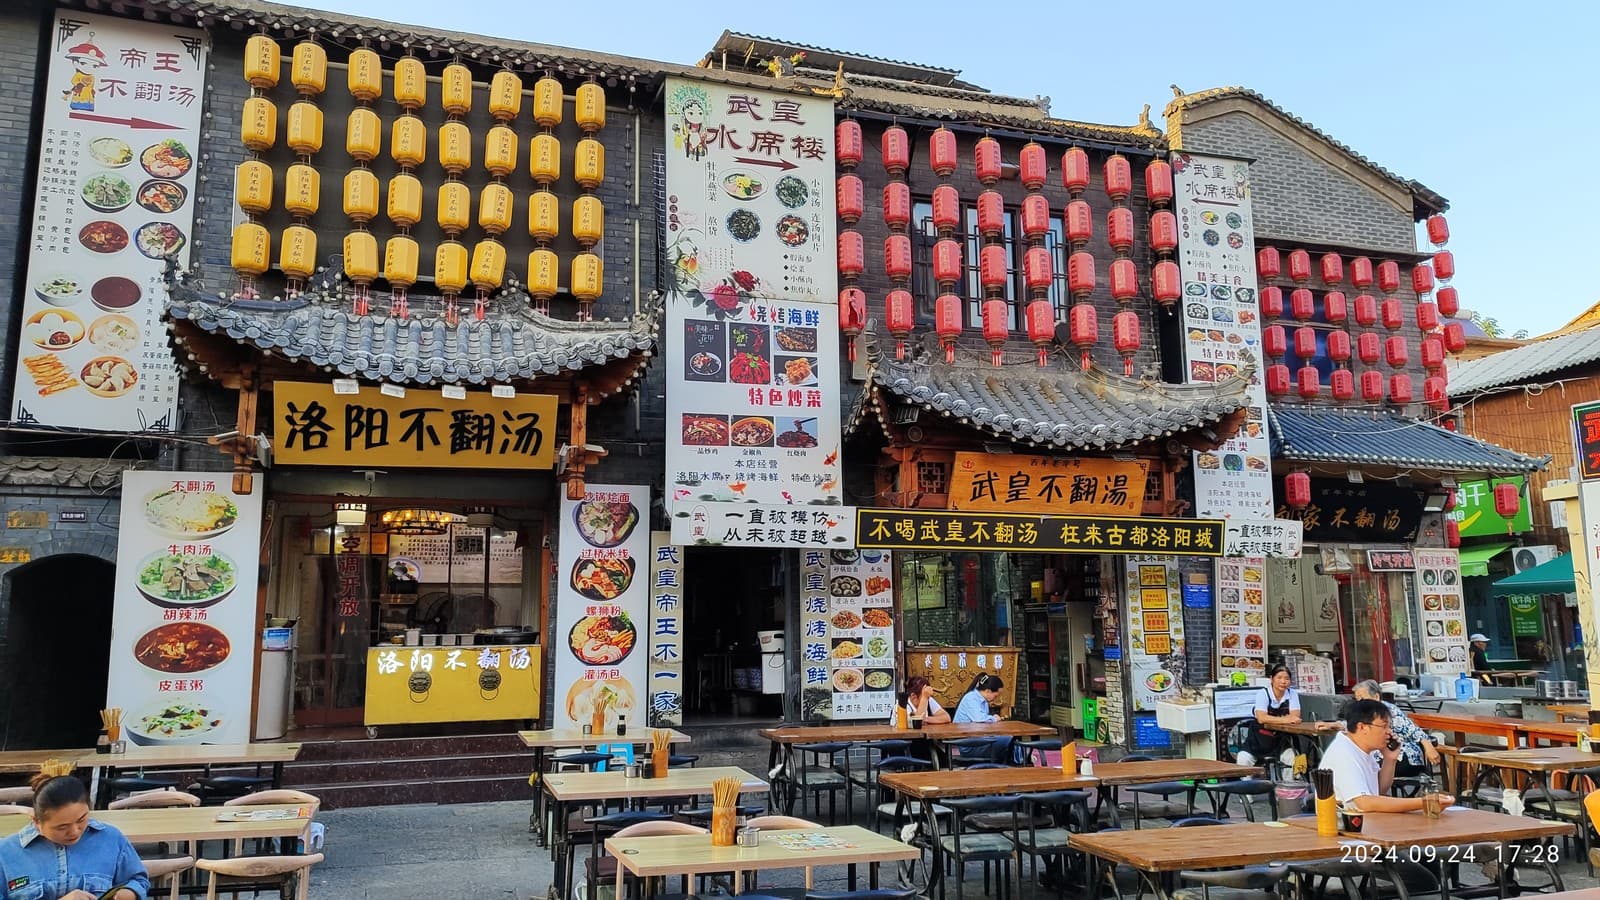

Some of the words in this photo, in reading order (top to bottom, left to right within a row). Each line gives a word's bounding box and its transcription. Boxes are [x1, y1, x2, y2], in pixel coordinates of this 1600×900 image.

[119, 47, 182, 73] 帝王
[98, 78, 197, 108] 不翻汤
[727, 95, 806, 125] 武皇
[706, 124, 827, 161] 水席楼
[1193, 163, 1227, 180] 武皇
[1185, 181, 1236, 200] 水席楼
[750, 304, 820, 326] 烧烤海鲜
[748, 387, 822, 408] 特色炒菜
[284, 400, 544, 456] 洛阳不翻汤
[734, 459, 779, 469] 本店经营
[171, 480, 216, 493] 不翻汤
[969, 470, 1129, 506] 武皇不翻湯
[693, 512, 705, 537] 武皇
[724, 508, 829, 525] 一直被模仿
[722, 527, 829, 545] 从未被超越
[868, 518, 1039, 544] 不喝武皇不翻汤
[1228, 524, 1284, 538] 一直被模仿
[167, 544, 212, 556] 牛肉汤
[581, 548, 630, 559] 过桥米线
[338, 535, 361, 617] 空调开放
[163, 609, 208, 621] 胡辣汤
[805, 551, 828, 685] 武皇烧烤海鲜
[655, 546, 680, 711] 武皇帝王不一家
[377, 647, 531, 675] 洛阳不翻汤
[584, 669, 621, 680] 灌汤包
[158, 679, 204, 692] 皮蛋粥
